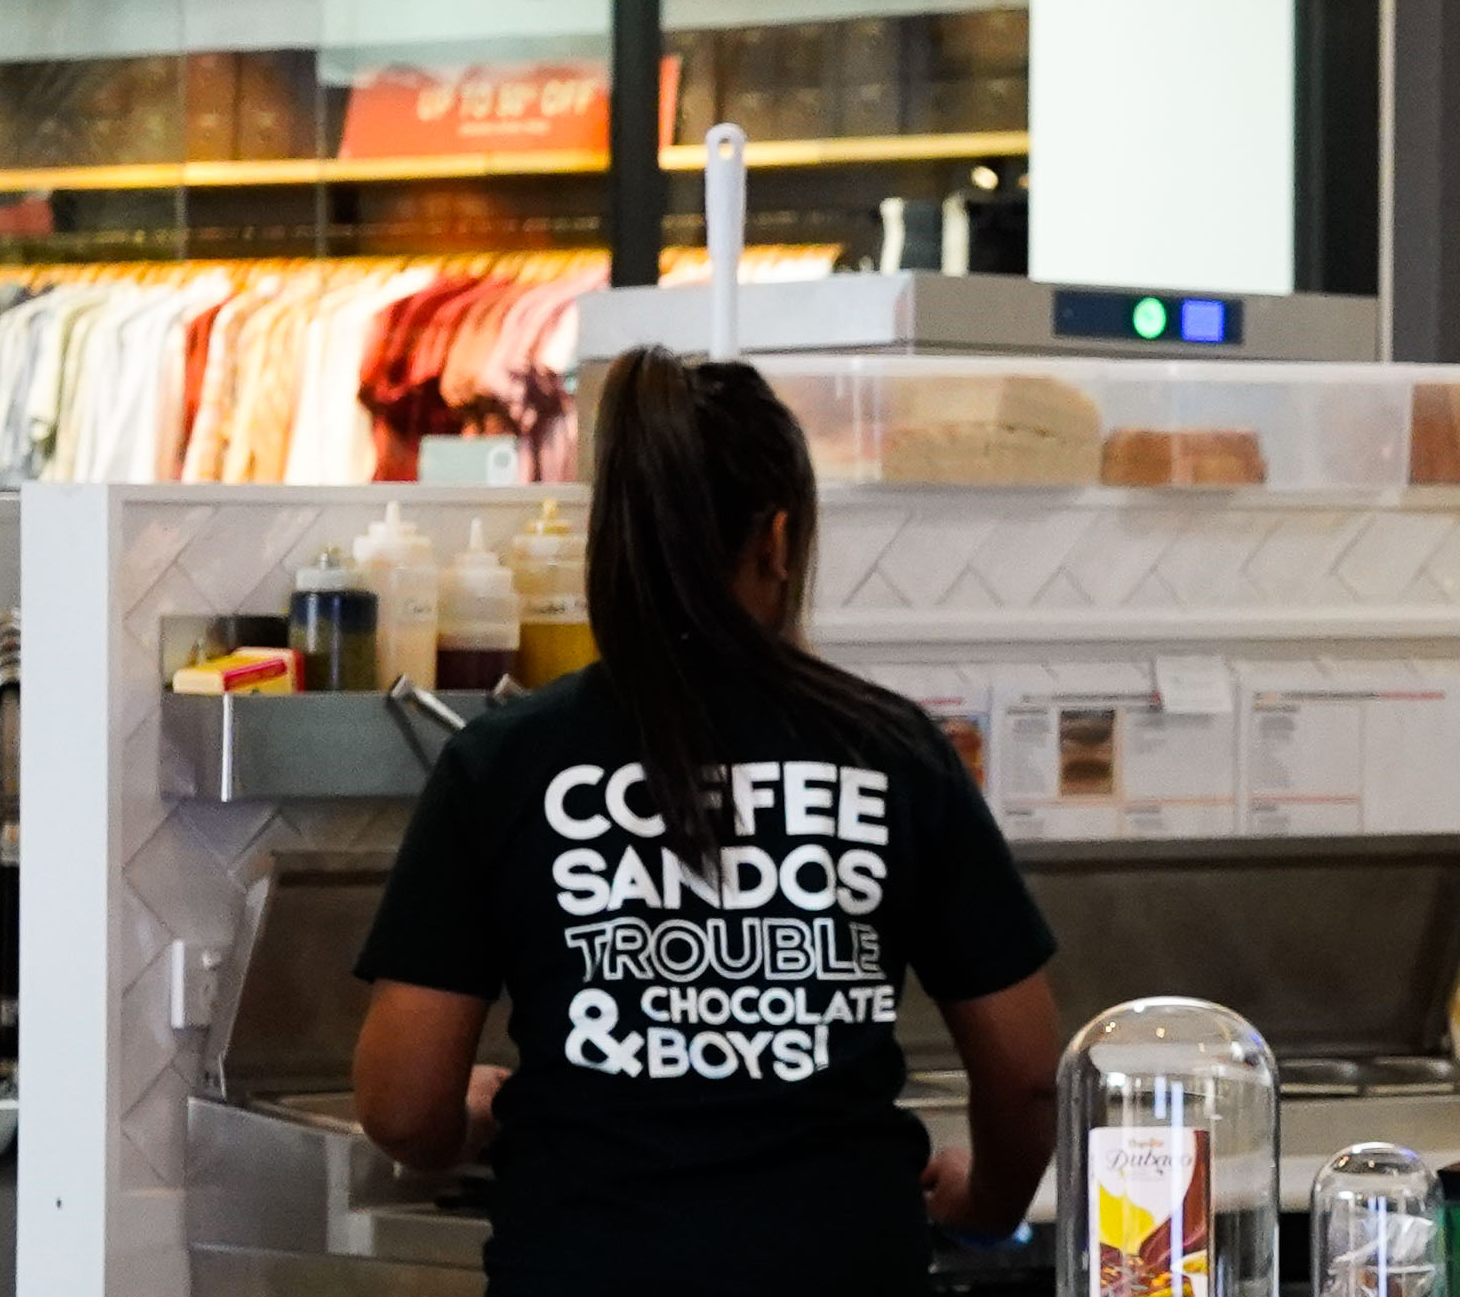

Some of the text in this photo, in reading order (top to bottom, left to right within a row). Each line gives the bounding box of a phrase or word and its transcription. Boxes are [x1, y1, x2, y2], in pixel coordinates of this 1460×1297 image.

[545, 760, 889, 846] COFEE
[551, 844, 888, 916] SANDOS
[565, 917, 886, 982] TROUBLE
[565, 985, 897, 1078] & CHOCOLATE
[648, 1025, 829, 1082] BOYS!
